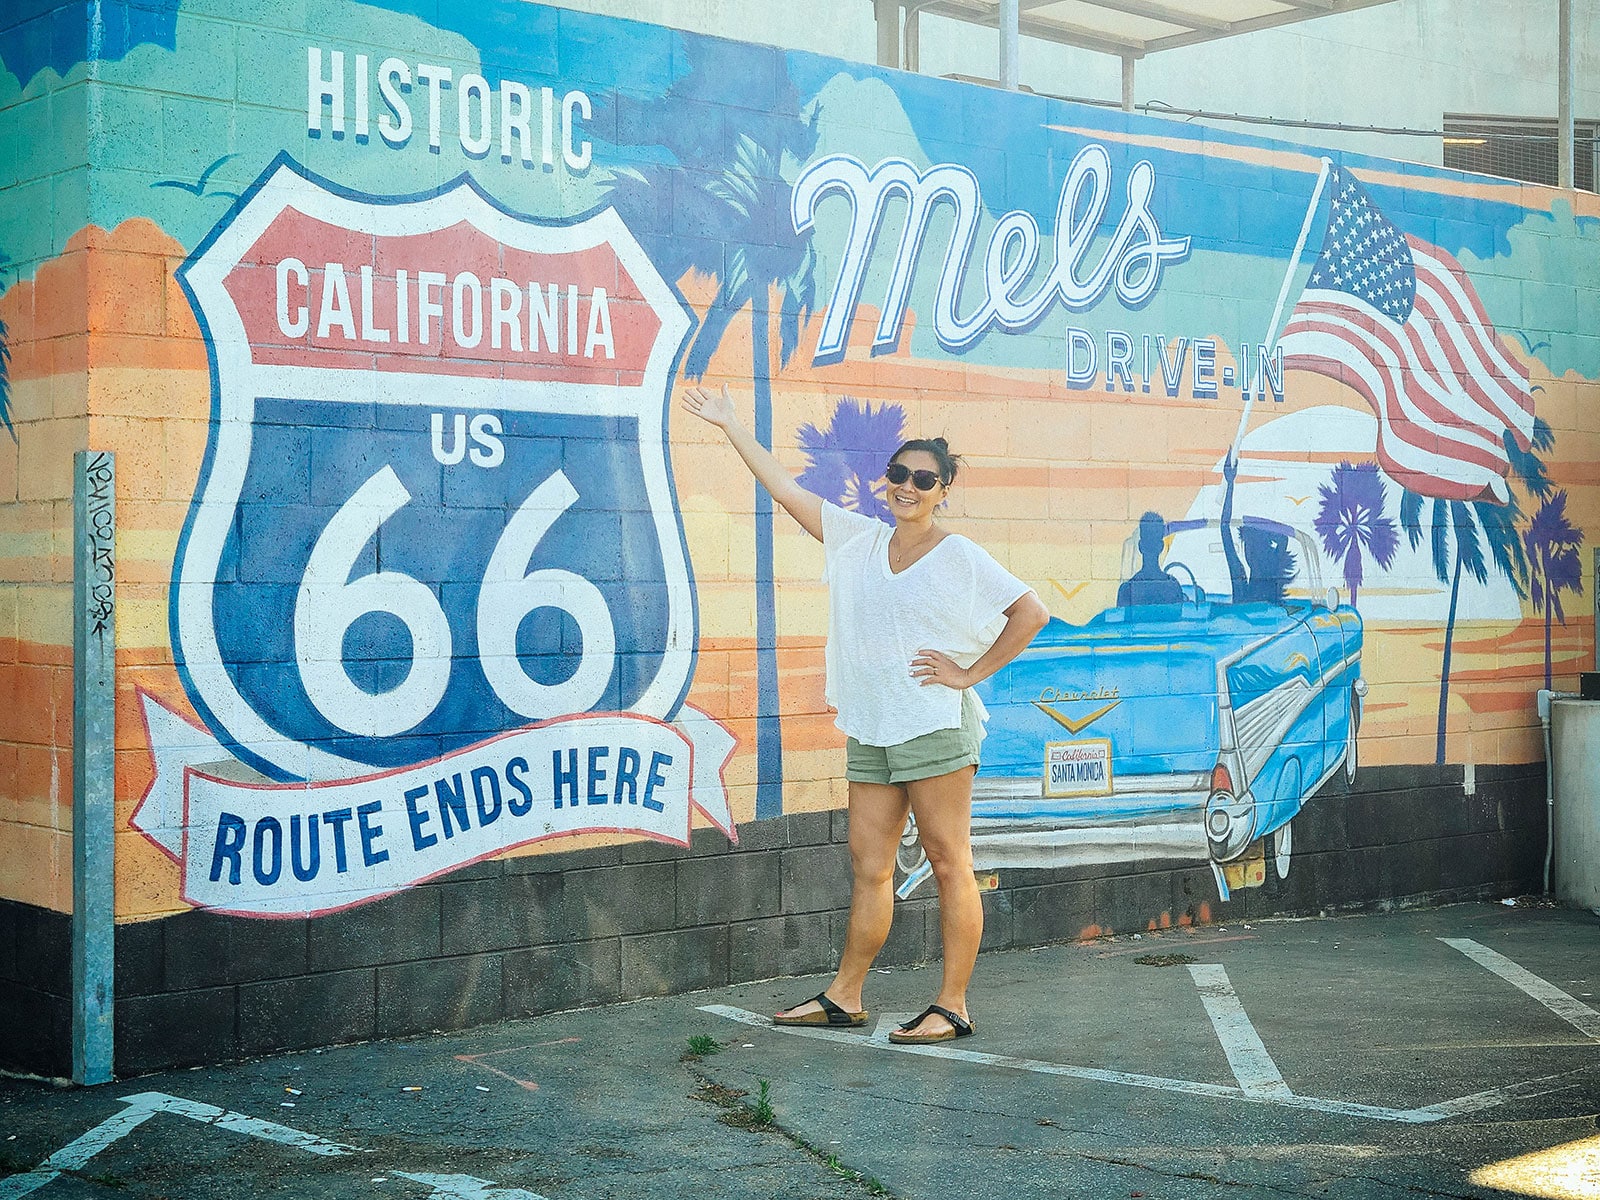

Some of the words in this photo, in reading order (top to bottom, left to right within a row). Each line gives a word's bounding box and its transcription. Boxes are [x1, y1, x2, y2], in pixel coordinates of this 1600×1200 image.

[307, 47, 593, 171] HISTORIC
[790, 143, 1192, 367] Mels
[276, 257, 616, 360] CALIFORNIA
[1065, 327, 1285, 402] DRIVE-IN
[431, 413, 505, 468] US
[294, 464, 615, 738] 66
[1040, 686, 1120, 702] Chevrolet
[1051, 763, 1076, 783] SANTA
[1076, 761, 1105, 782] MONICA
[1061, 749, 1100, 761] California
[209, 800, 390, 886] ROUTE
[410, 755, 533, 851] ENDS
[552, 745, 674, 814] HERE
